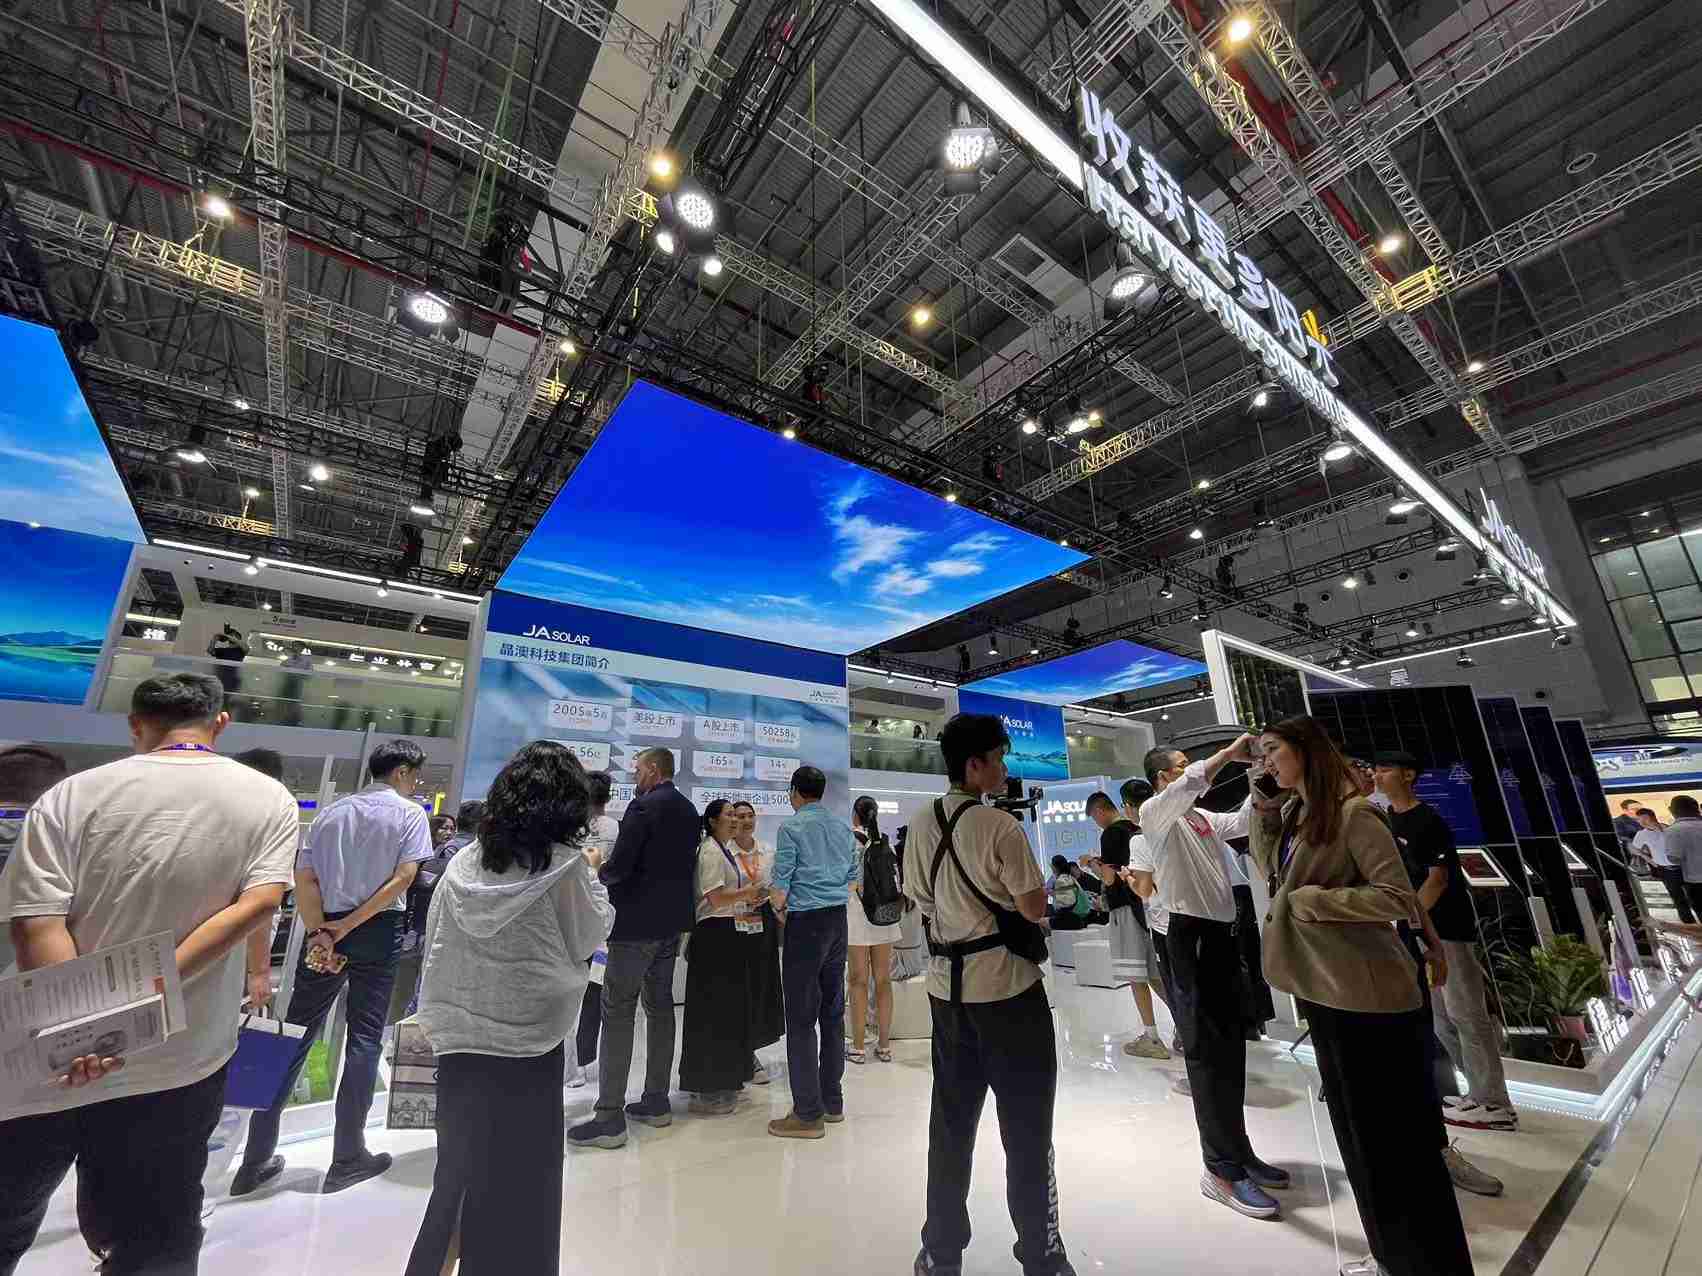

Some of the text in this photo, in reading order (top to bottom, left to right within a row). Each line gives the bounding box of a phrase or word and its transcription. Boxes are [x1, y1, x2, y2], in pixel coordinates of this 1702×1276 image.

[1084, 161, 1218, 313] Harvest
[499, 642, 610, 670] 晶澳科技集团简介
